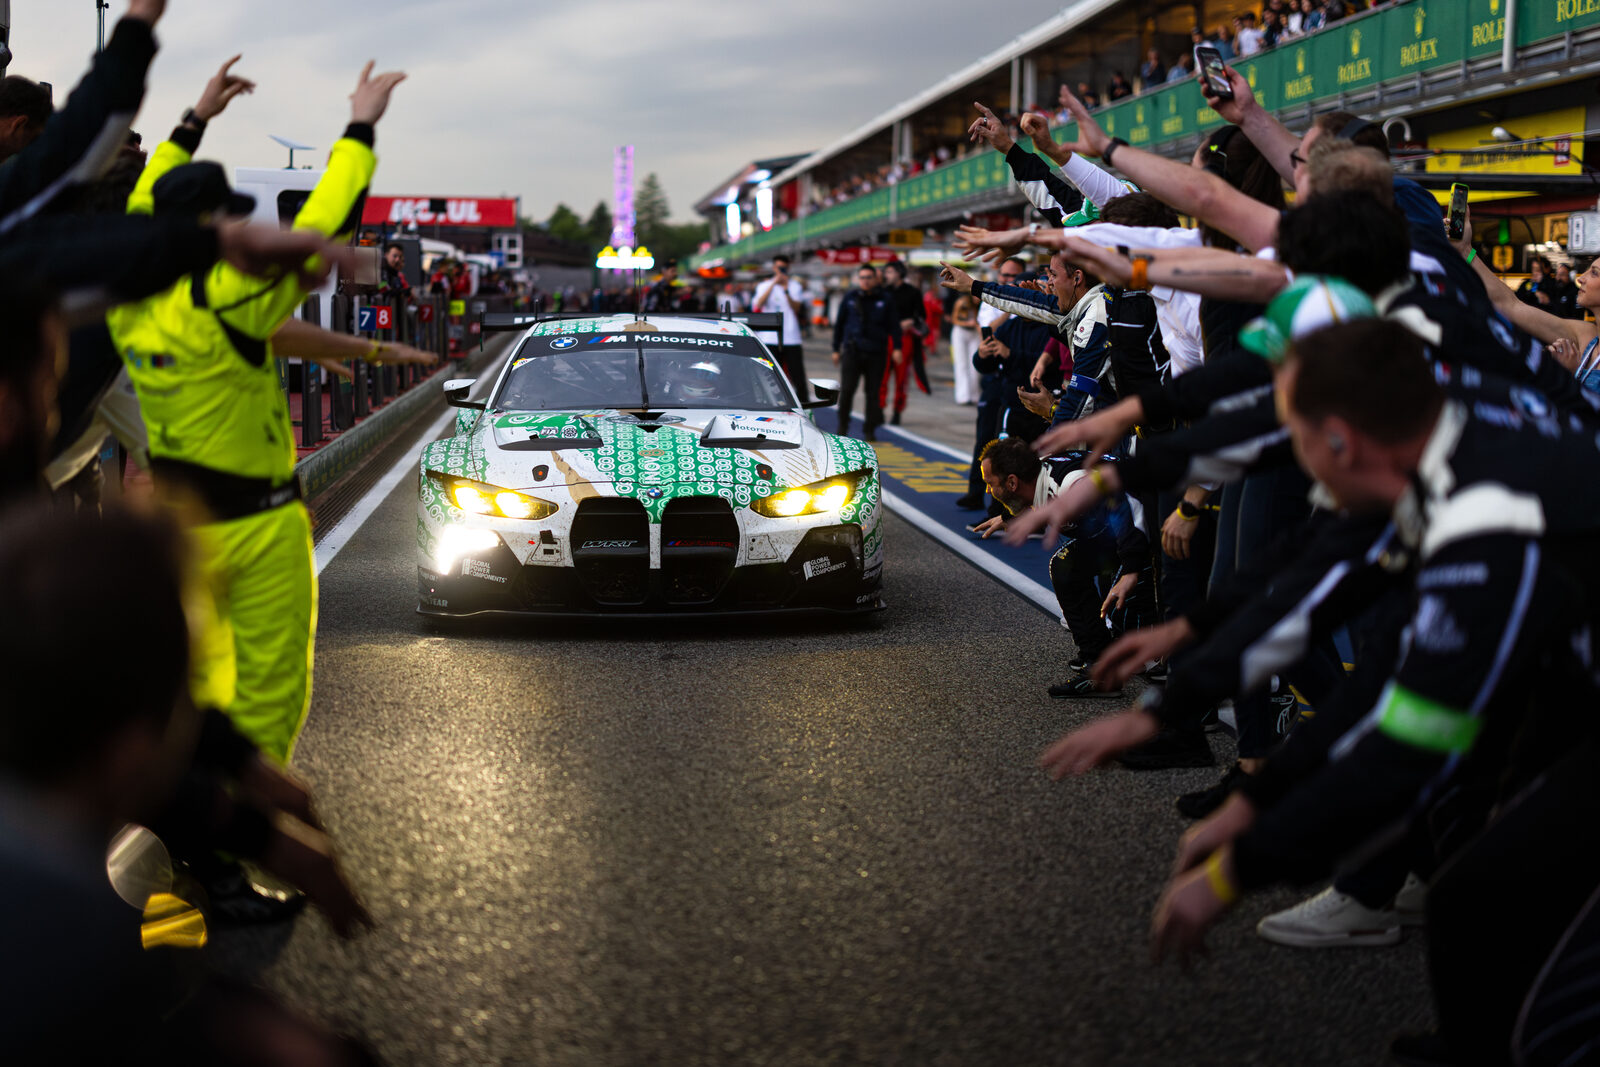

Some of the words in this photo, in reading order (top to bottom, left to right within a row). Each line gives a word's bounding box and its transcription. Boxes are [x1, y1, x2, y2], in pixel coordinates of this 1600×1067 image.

[1556, 0, 1600, 22] ROLE
[1472, 18, 1504, 47] ROLE
[1400, 37, 1438, 67] ROLEX
[389, 200, 481, 222] MOUL
[361, 311, 370, 327] 7
[379, 310, 388, 325] 8
[634, 335, 734, 348] Motorsport
[470, 559, 491, 569] GLOBAL
[810, 556, 830, 566] GLOBAL
[811, 561, 831, 571] POWER
[470, 565, 490, 575] POWER
[812, 561, 847, 577] COMPONENTS
